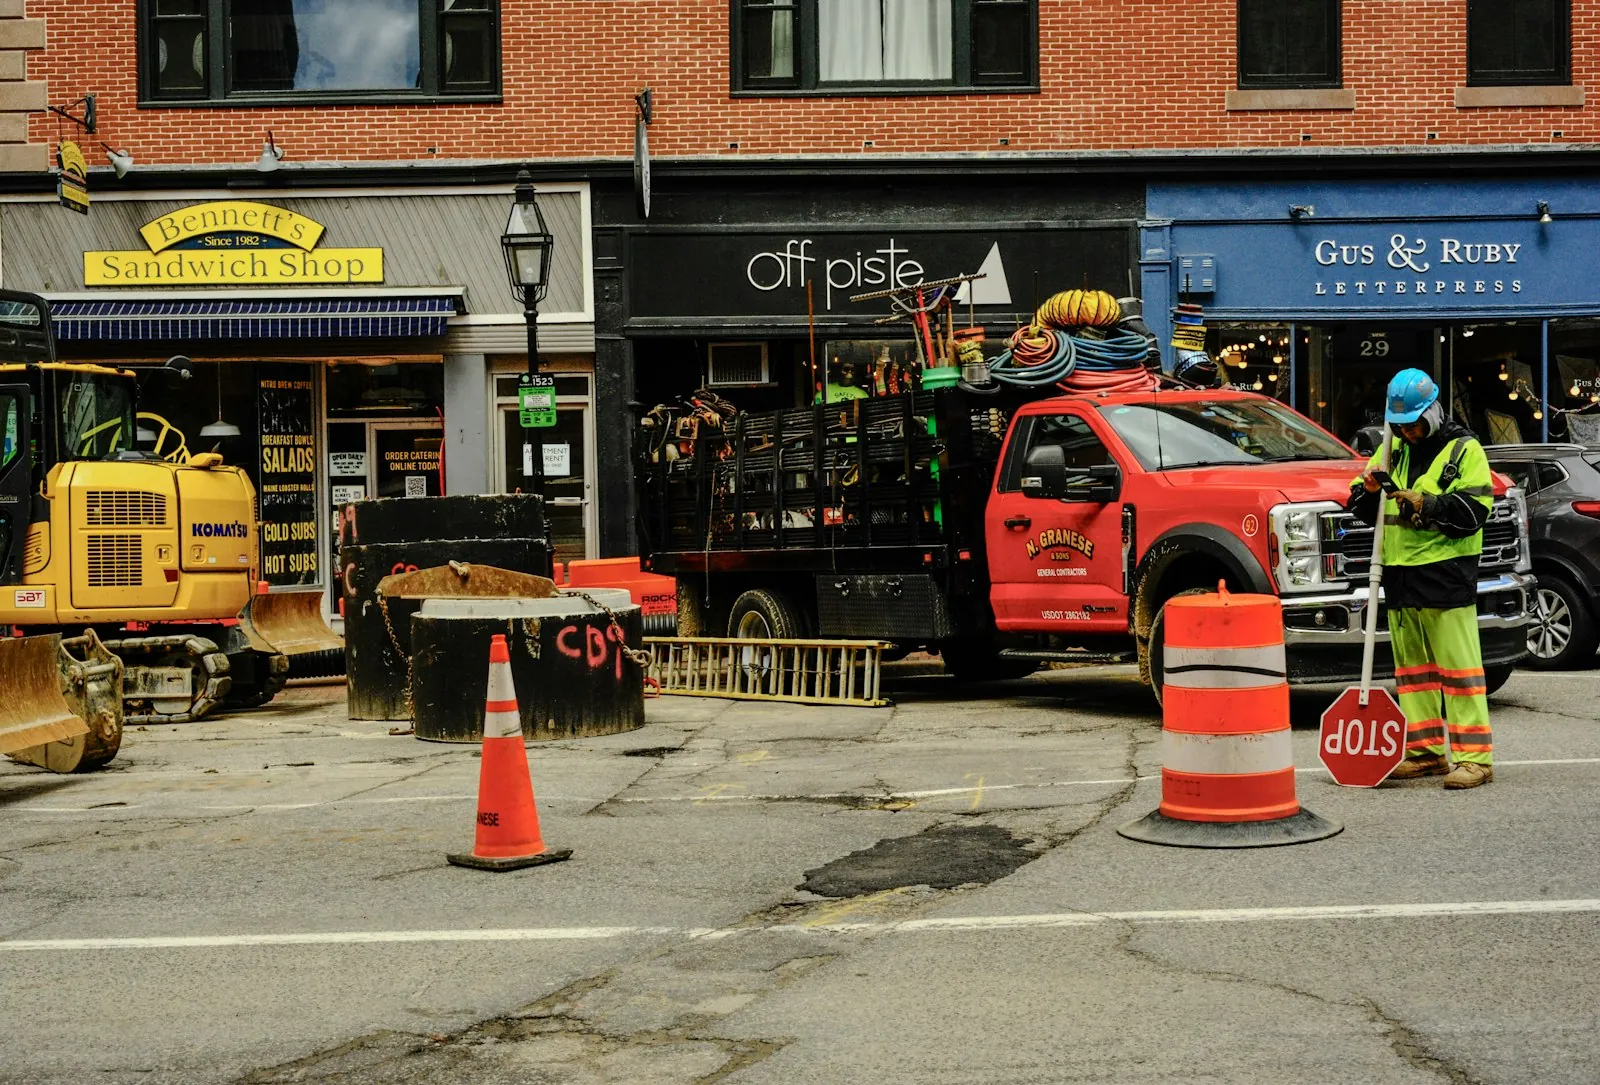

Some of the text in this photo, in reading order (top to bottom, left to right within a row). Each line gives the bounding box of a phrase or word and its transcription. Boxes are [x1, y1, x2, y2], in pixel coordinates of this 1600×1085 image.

[155, 205, 306, 243] Bennett's
[205, 235, 260, 247] Since 1982
[1387, 233, 1430, 273] &
[103, 252, 365, 282] Sandwich Shop
[747, 238, 924, 311] off piste
[1315, 280, 1522, 296] LETTERPRESS
[1360, 340, 1390, 357] 29
[261, 380, 313, 390] NITRO BREW COFFEE
[532, 377, 554, 386] 1523
[262, 434, 313, 446] BREAKFAST BOWLS
[263, 447, 314, 473] SALADS
[332, 453, 364, 461] OPEN DAILY
[385, 451, 442, 461] ORDER CATERIN
[390, 461, 441, 471] ONLINE TODAY
[279, 484, 299, 492] LOBSTER
[300, 484, 314, 492] ROLLS
[192, 520, 248, 538] KOMATSU
[264, 521, 316, 542] COLD SUBS
[1245, 519, 1255, 532] 92
[1026, 528, 1094, 559] N. GRANESE
[265, 552, 317, 575] HOT SUBS
[1051, 552, 1070, 561] & SONS
[1037, 568, 1087, 577] GENERAL CONTRACTORS
[1041, 610, 1064, 620] USDOT
[556, 624, 626, 683] CD9
[1325, 719, 1400, 756] STOP
